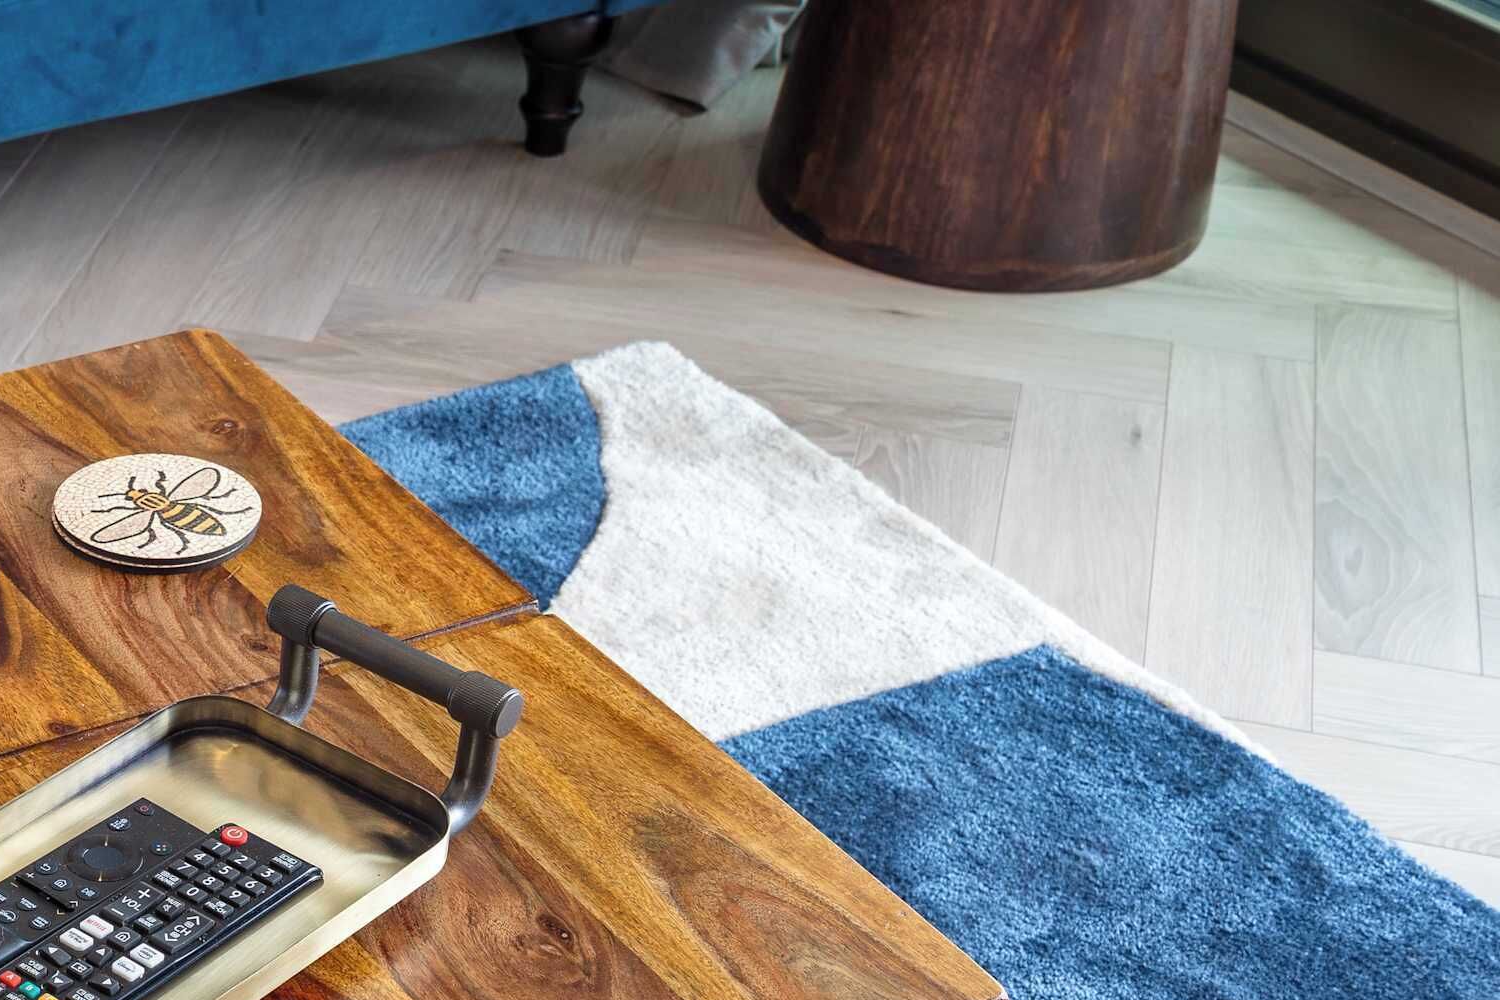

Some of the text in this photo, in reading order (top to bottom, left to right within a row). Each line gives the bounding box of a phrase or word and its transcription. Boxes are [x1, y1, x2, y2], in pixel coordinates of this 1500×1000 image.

[193, 852, 257, 889] 4 5 6
[213, 841, 275, 878] 1 2 3
[177, 861, 243, 900] 7 8 9
[186, 887, 200, 897] 0
[121, 895, 143, 912] VOL
[174, 924, 192, 937] CH
